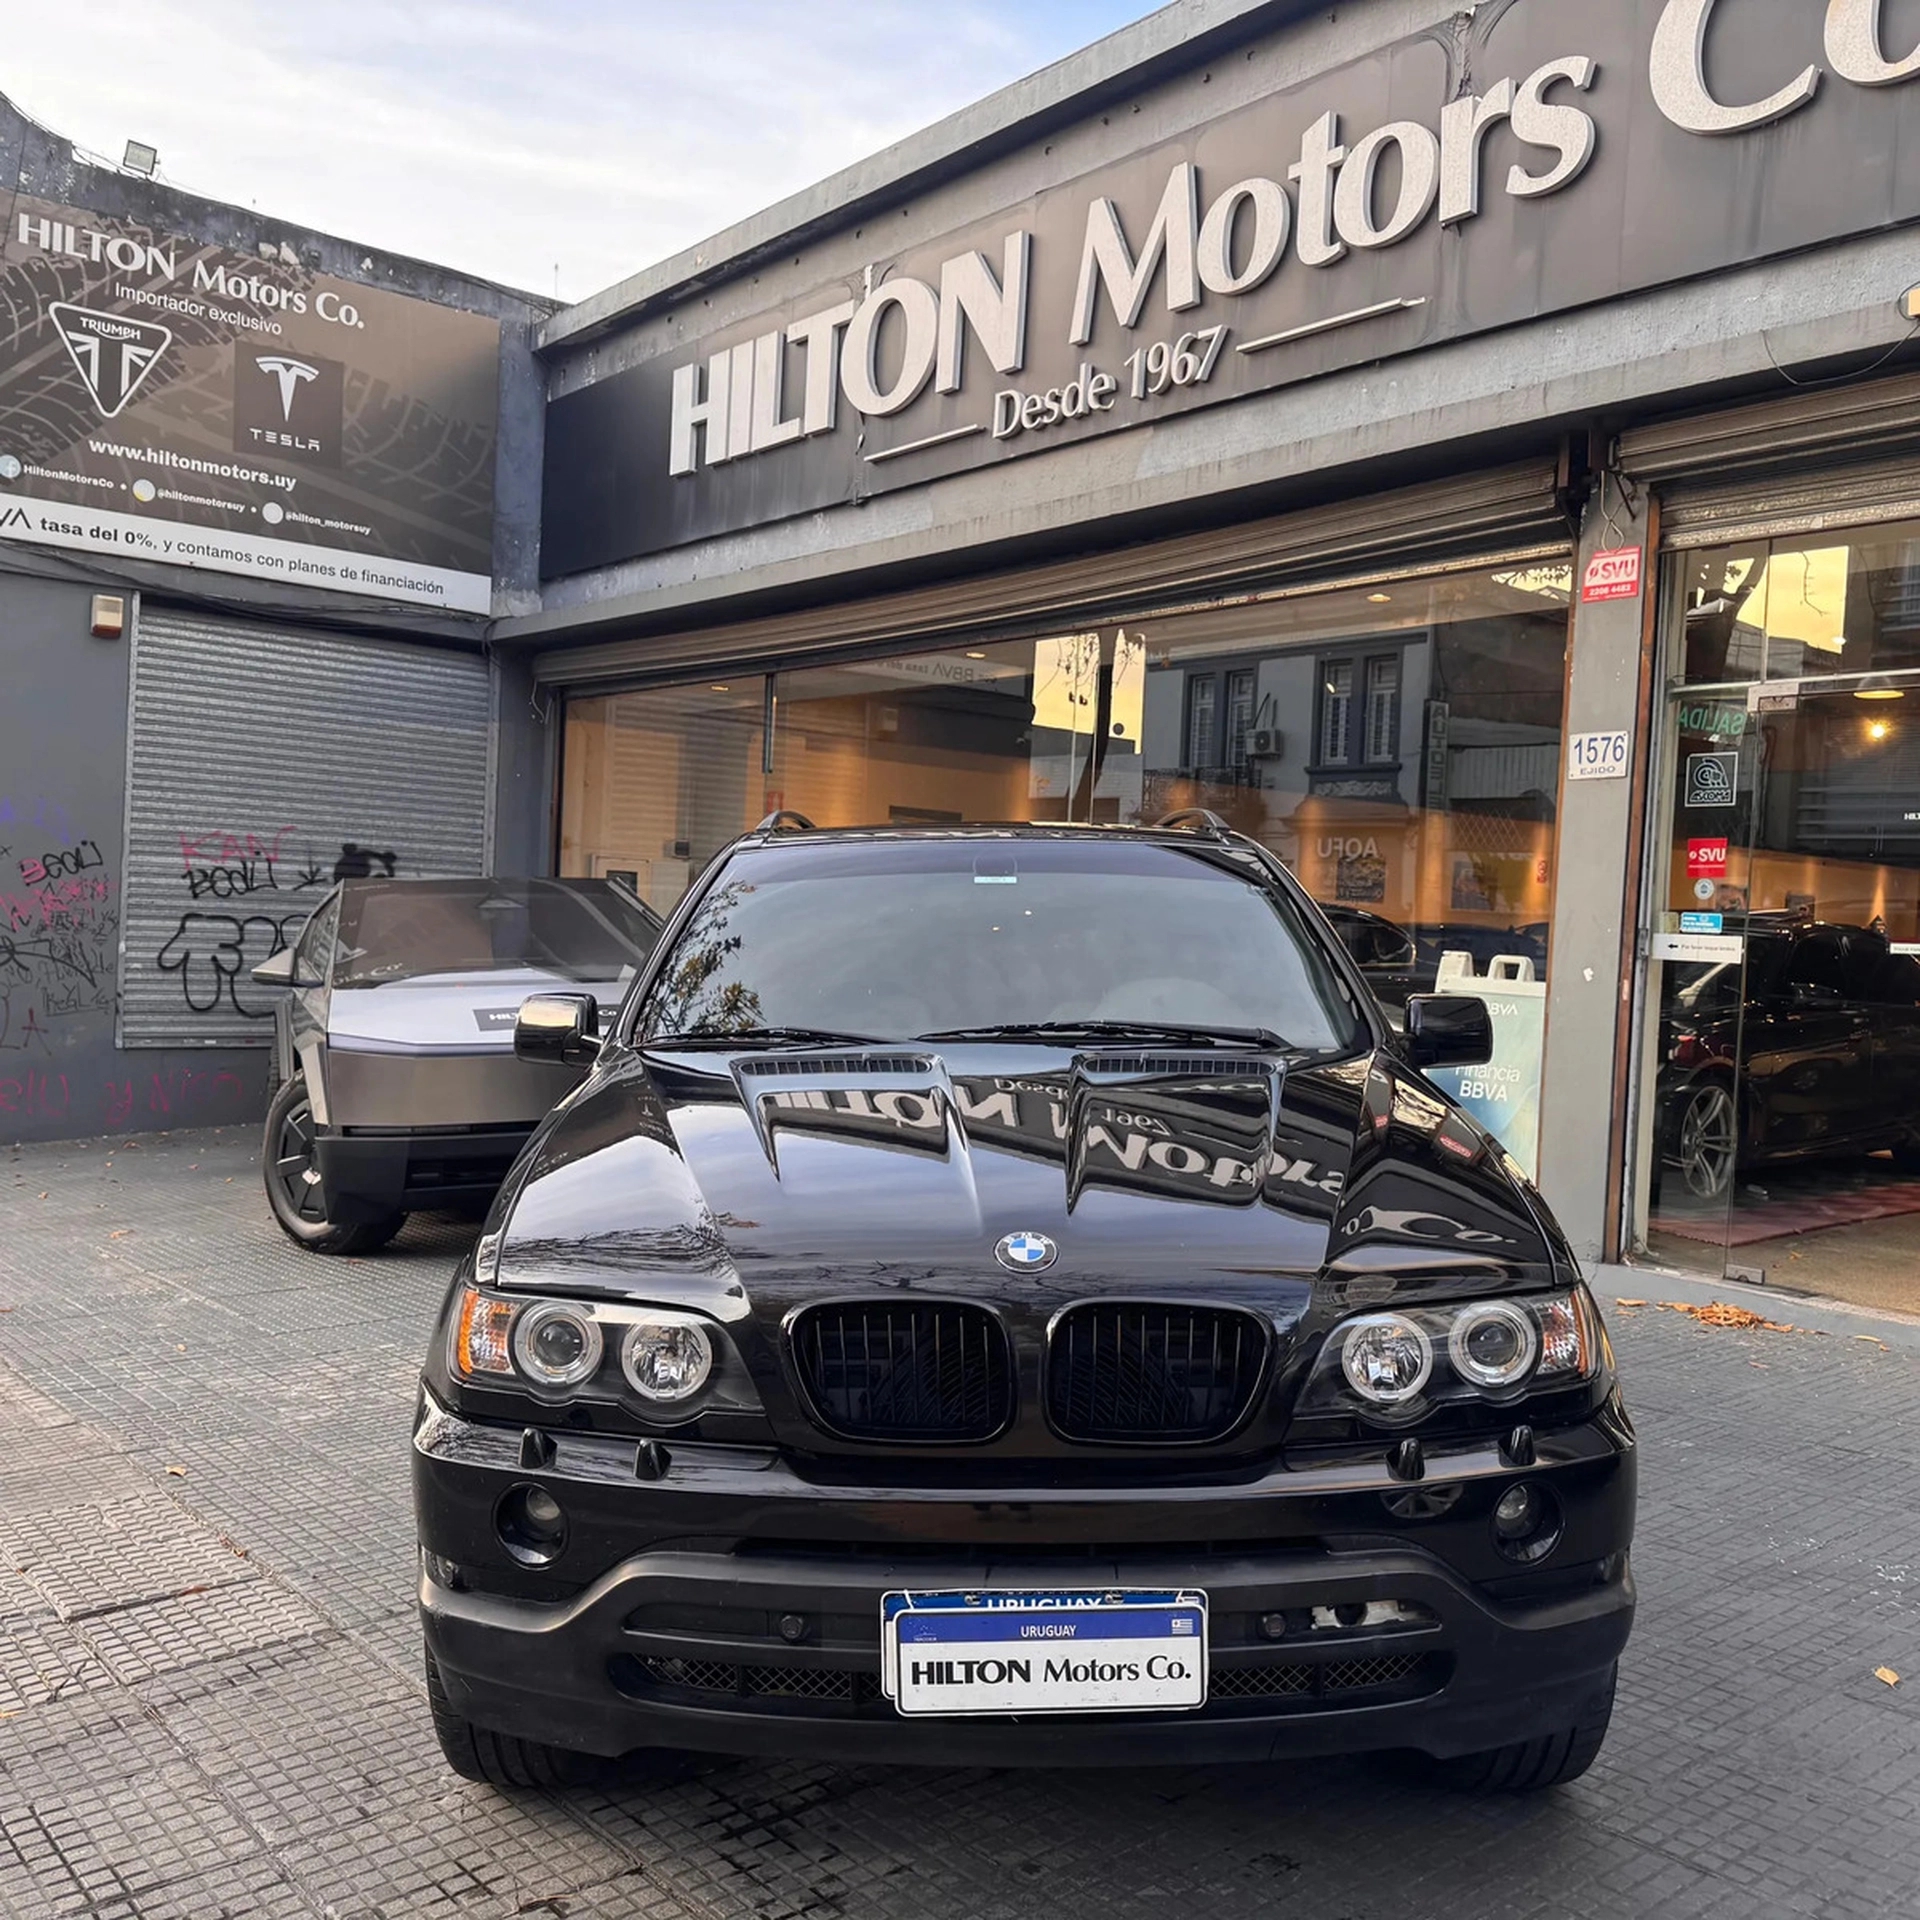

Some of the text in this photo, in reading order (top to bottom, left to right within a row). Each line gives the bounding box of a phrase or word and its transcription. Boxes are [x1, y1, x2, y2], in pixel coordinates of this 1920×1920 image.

[18, 212, 365, 329] HILTON Motors Co.
[669, 229, 1032, 478] HILTON
[1068, 55, 1600, 348] Motors
[115, 282, 282, 335] Importador exclusivo
[80, 316, 141, 340] TRIUMPH
[992, 324, 1231, 439] Desde 1967
[249, 428, 320, 452] TESLA
[23, 463, 114, 489] HiltonMotorsCo
[88, 439, 297, 491] www.hiltonmotors.uy
[40, 517, 83, 537] tasa
[90, 525, 118, 542] del
[125, 531, 157, 549] 0%,
[163, 539, 172, 553] y
[177, 542, 252, 564] contamos
[257, 554, 284, 568] con
[288, 558, 335, 577] planes
[340, 566, 357, 580] de
[361, 569, 444, 595] financiación
[1601, 558, 1635, 580] SVU
[1573, 735, 1625, 765] 1576
[1580, 766, 1616, 776] EJIDO
[1698, 847, 1727, 862] SVU
[1488, 1003, 1518, 1015] BVA
[1459, 1079, 1508, 1102] BBVA
[1020, 1624, 1077, 1638] URUGUAY
[911, 1655, 1192, 1686] HILTON Motors Co.
